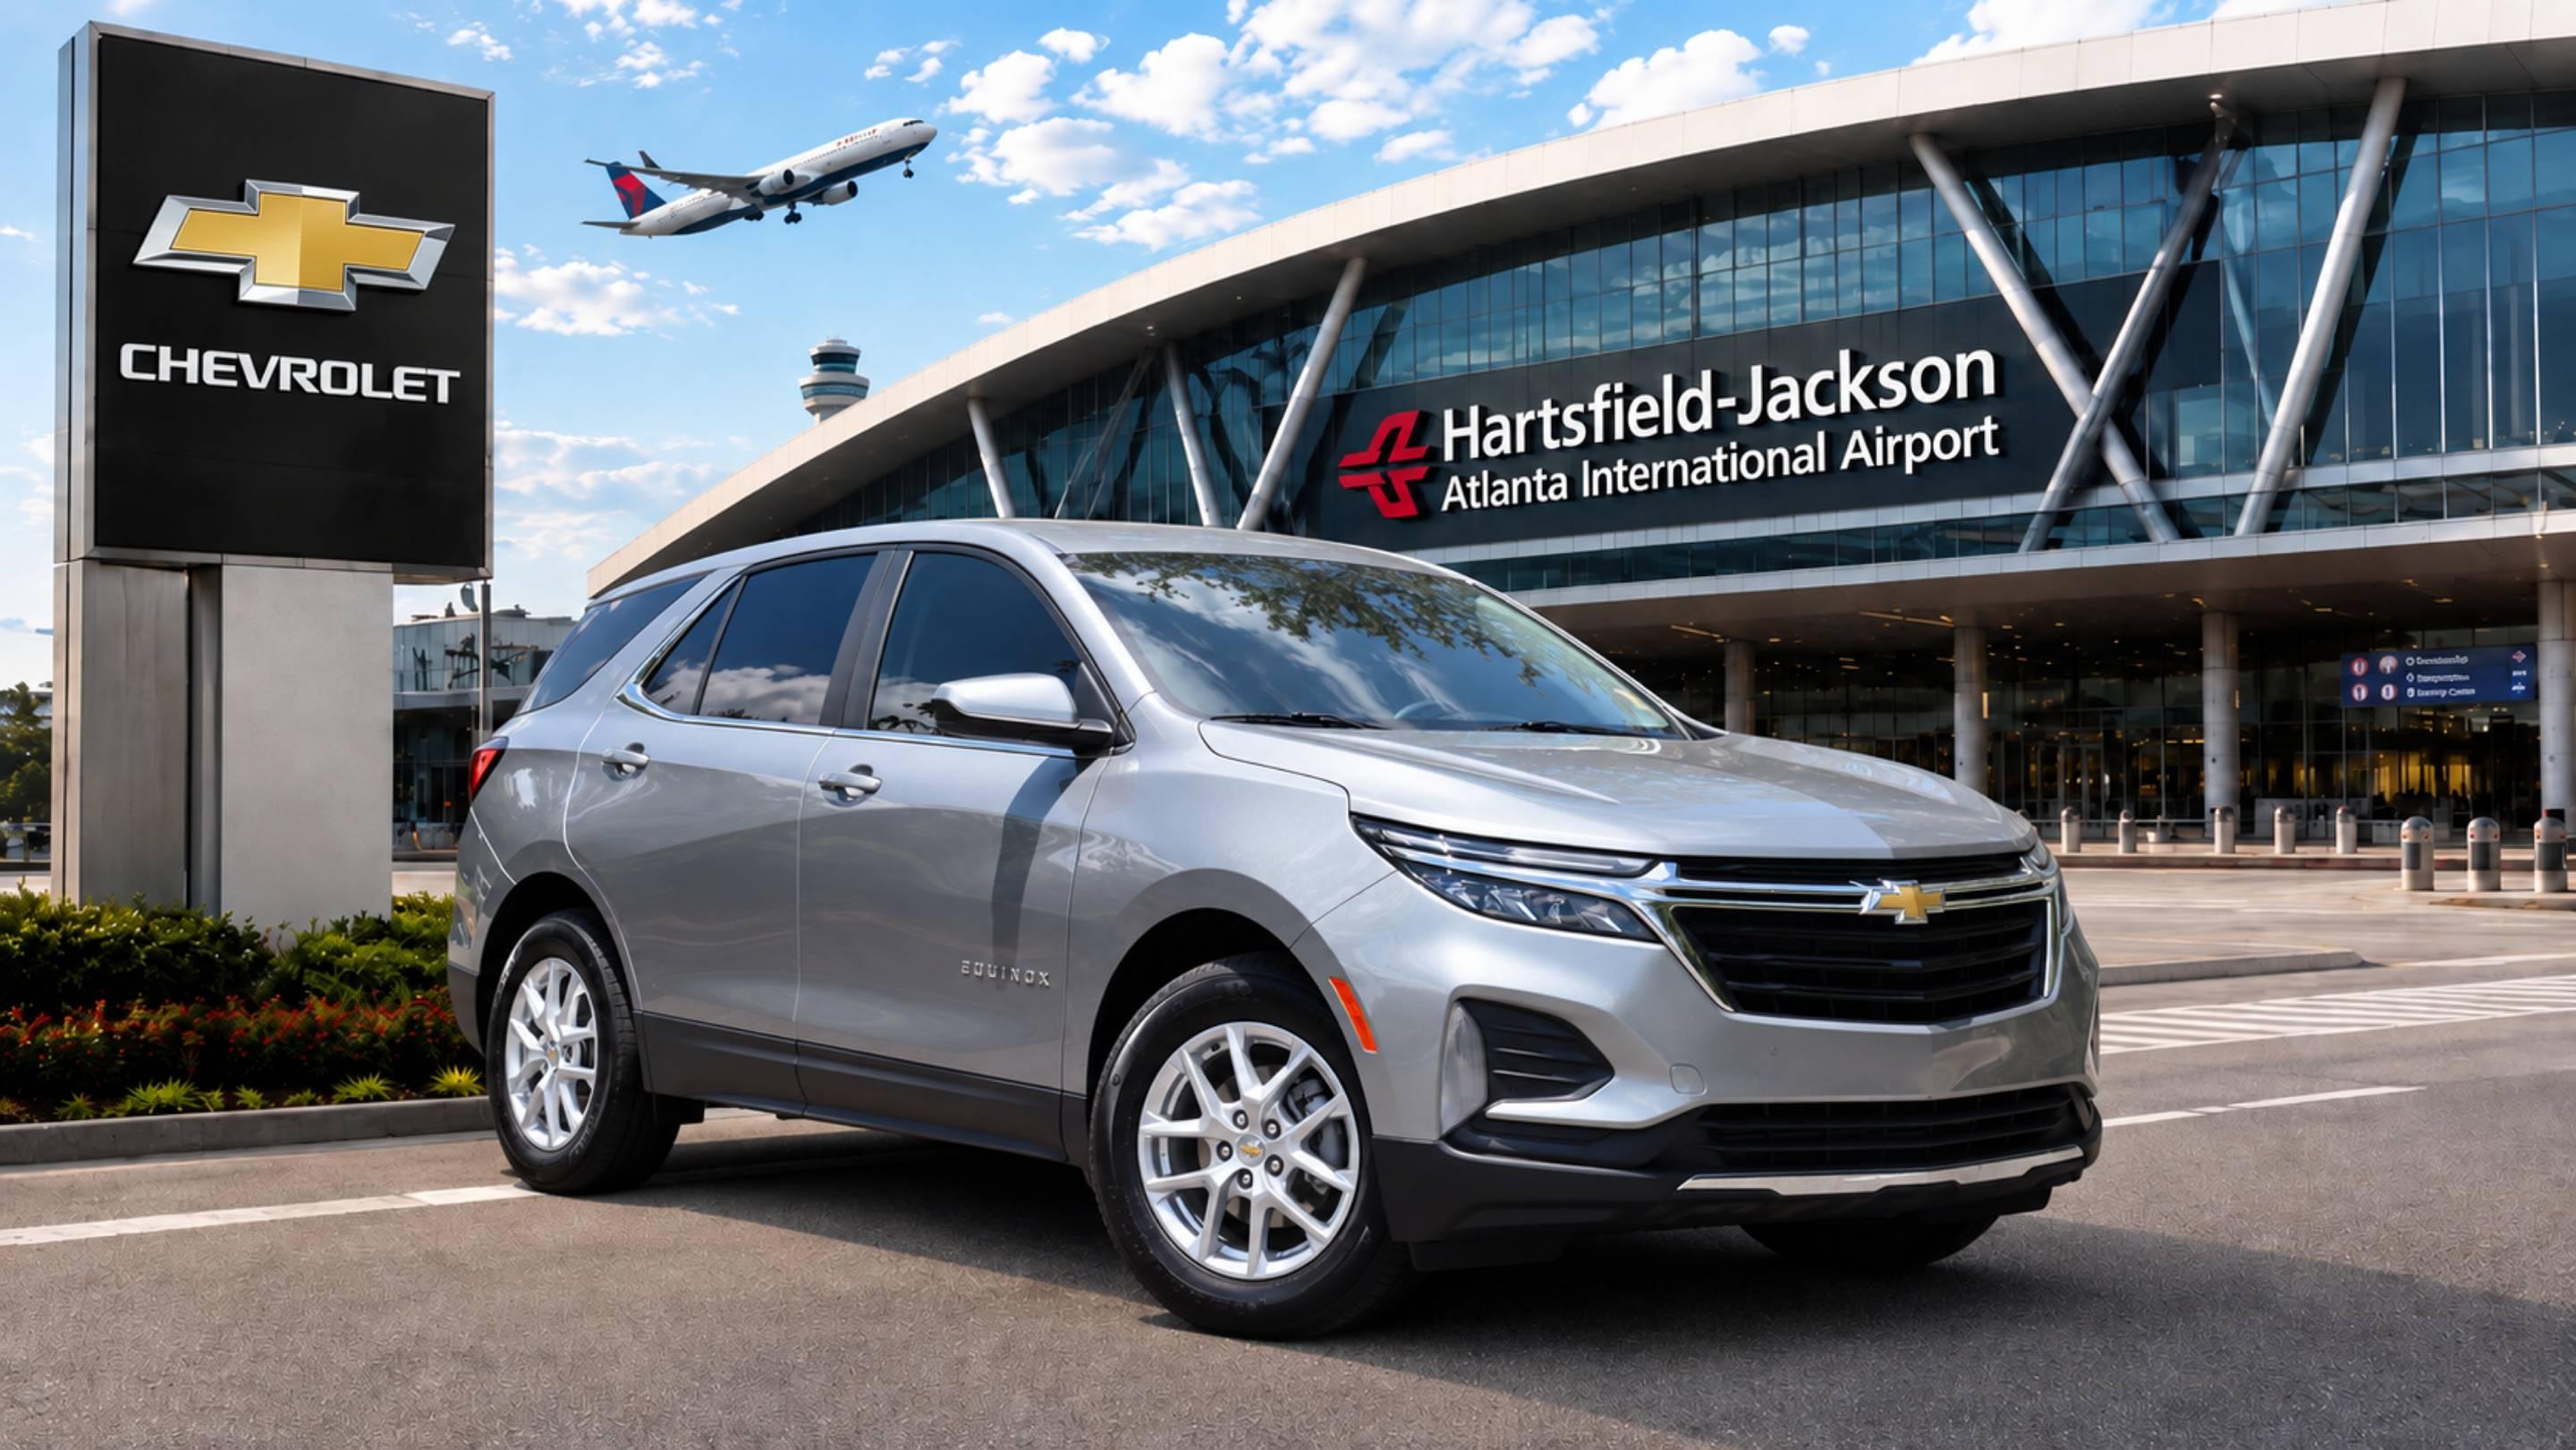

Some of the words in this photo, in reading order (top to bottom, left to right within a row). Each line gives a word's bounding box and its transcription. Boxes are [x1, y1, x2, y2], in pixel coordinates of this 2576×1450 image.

[120, 343, 461, 403] CHEVROLET
[1444, 348, 1996, 462] Hartsfield-Jackson
[1441, 468, 1568, 512] Atlanta
[1582, 429, 1826, 497] International
[1840, 415, 1999, 475] Airport
[961, 960, 1050, 987] EQUINOX
